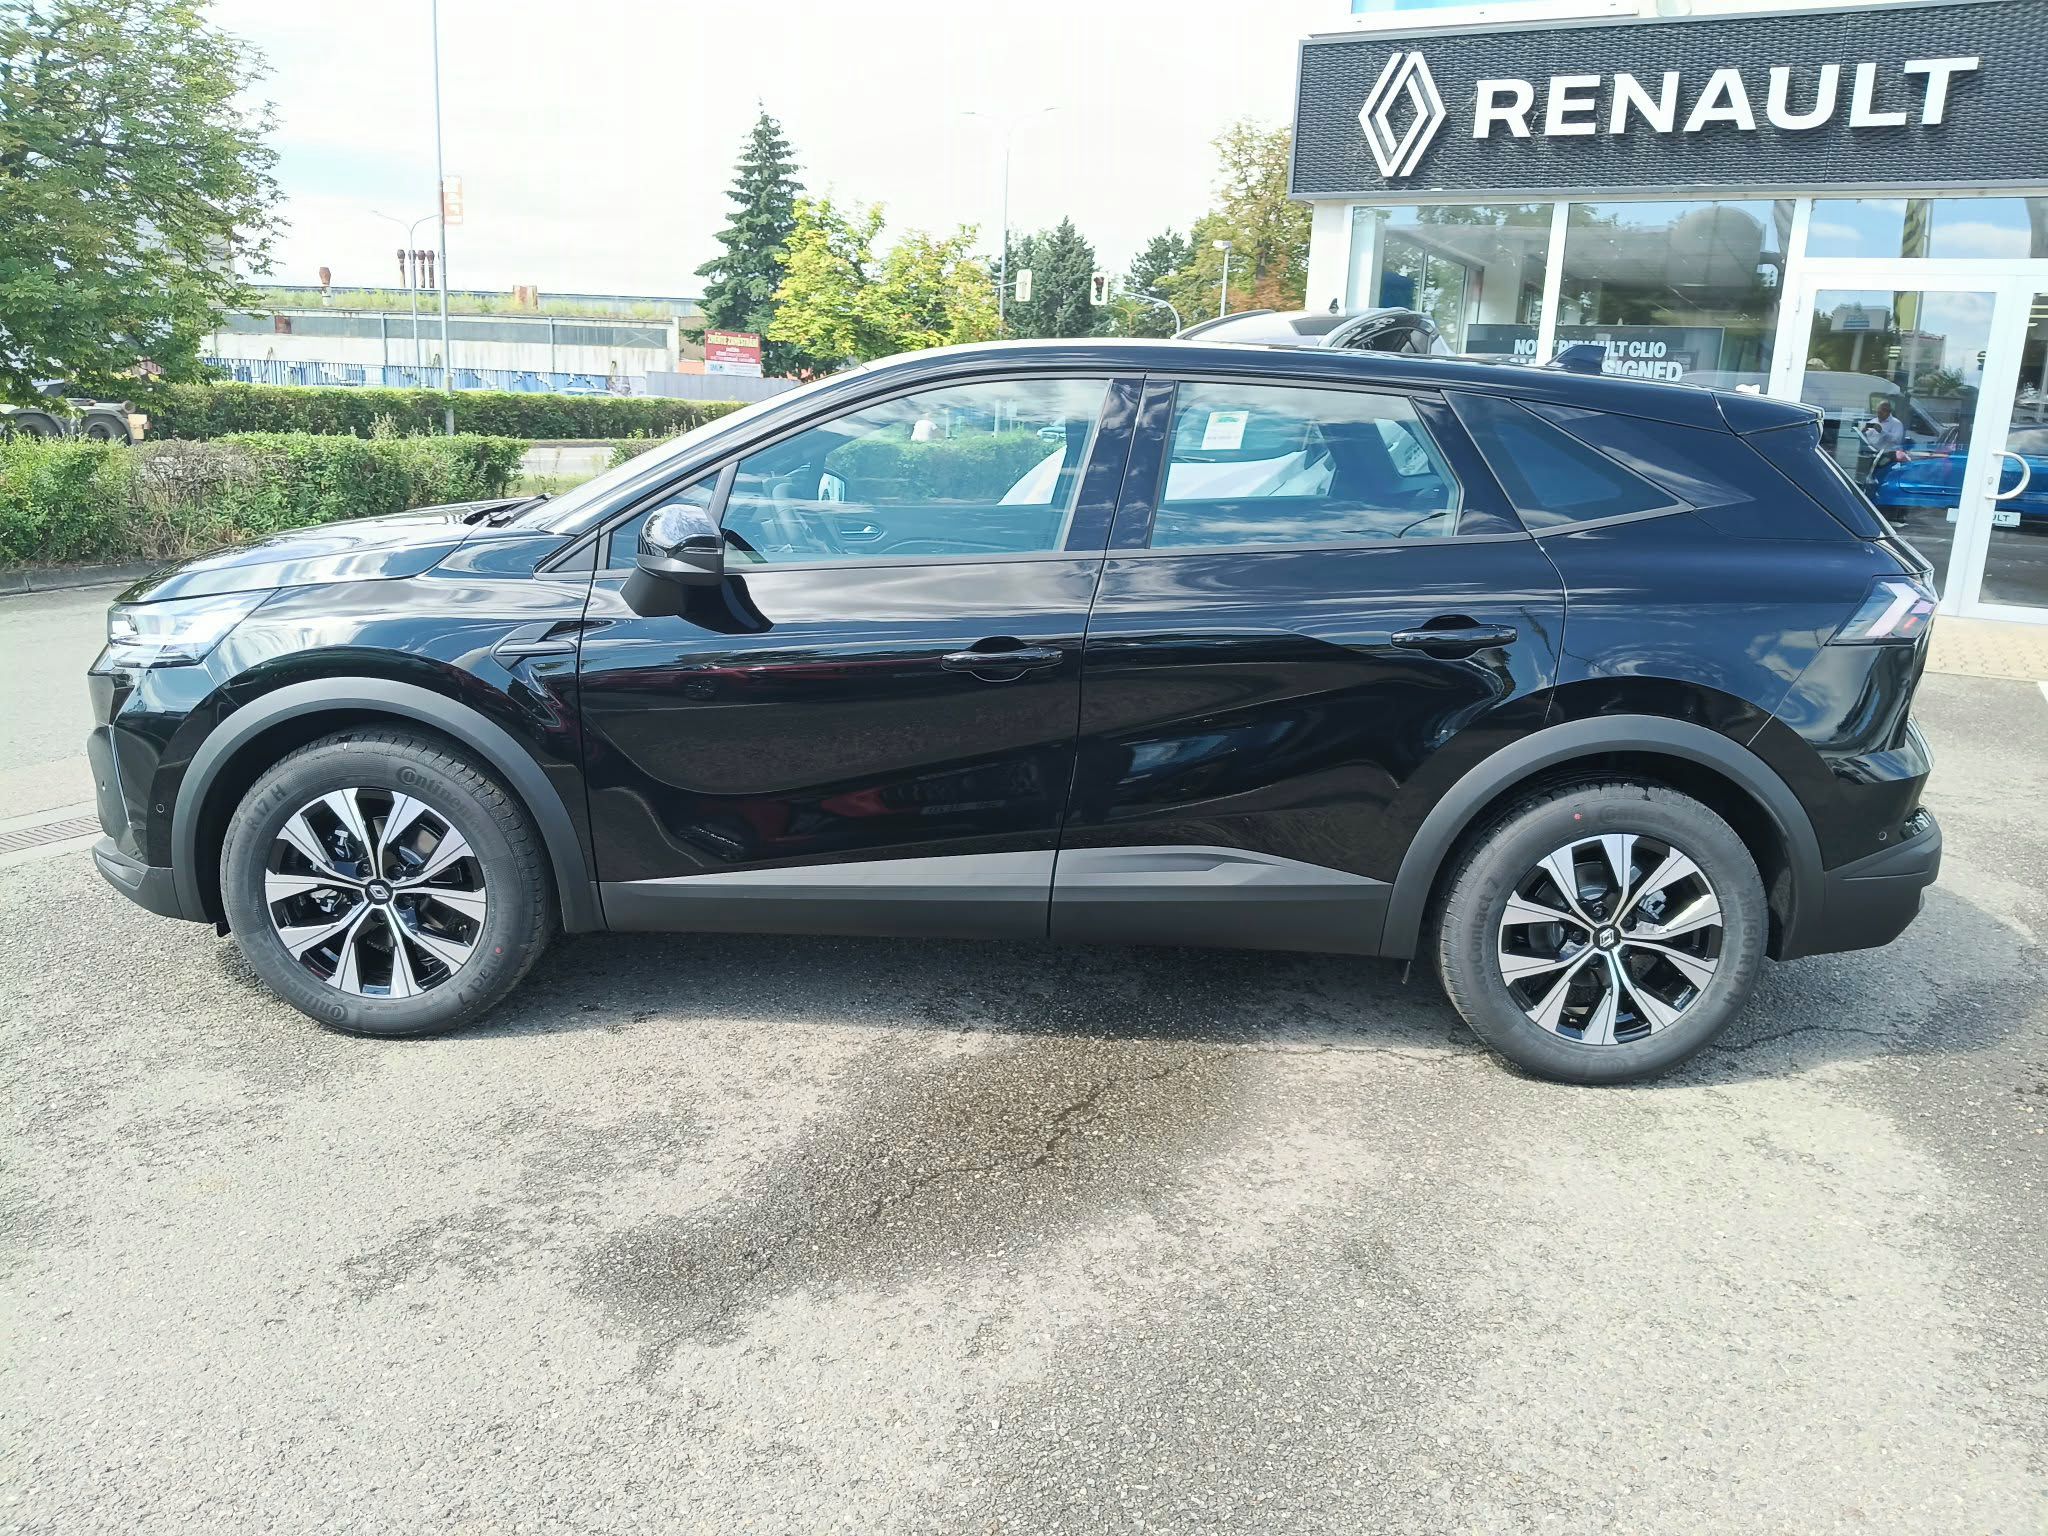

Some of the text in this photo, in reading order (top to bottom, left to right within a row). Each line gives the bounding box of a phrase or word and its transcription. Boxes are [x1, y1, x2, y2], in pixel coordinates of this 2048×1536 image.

[1473, 56, 1980, 139] RENAULT
[1628, 341, 1667, 358] CLIO
[271, 783, 287, 801] H
